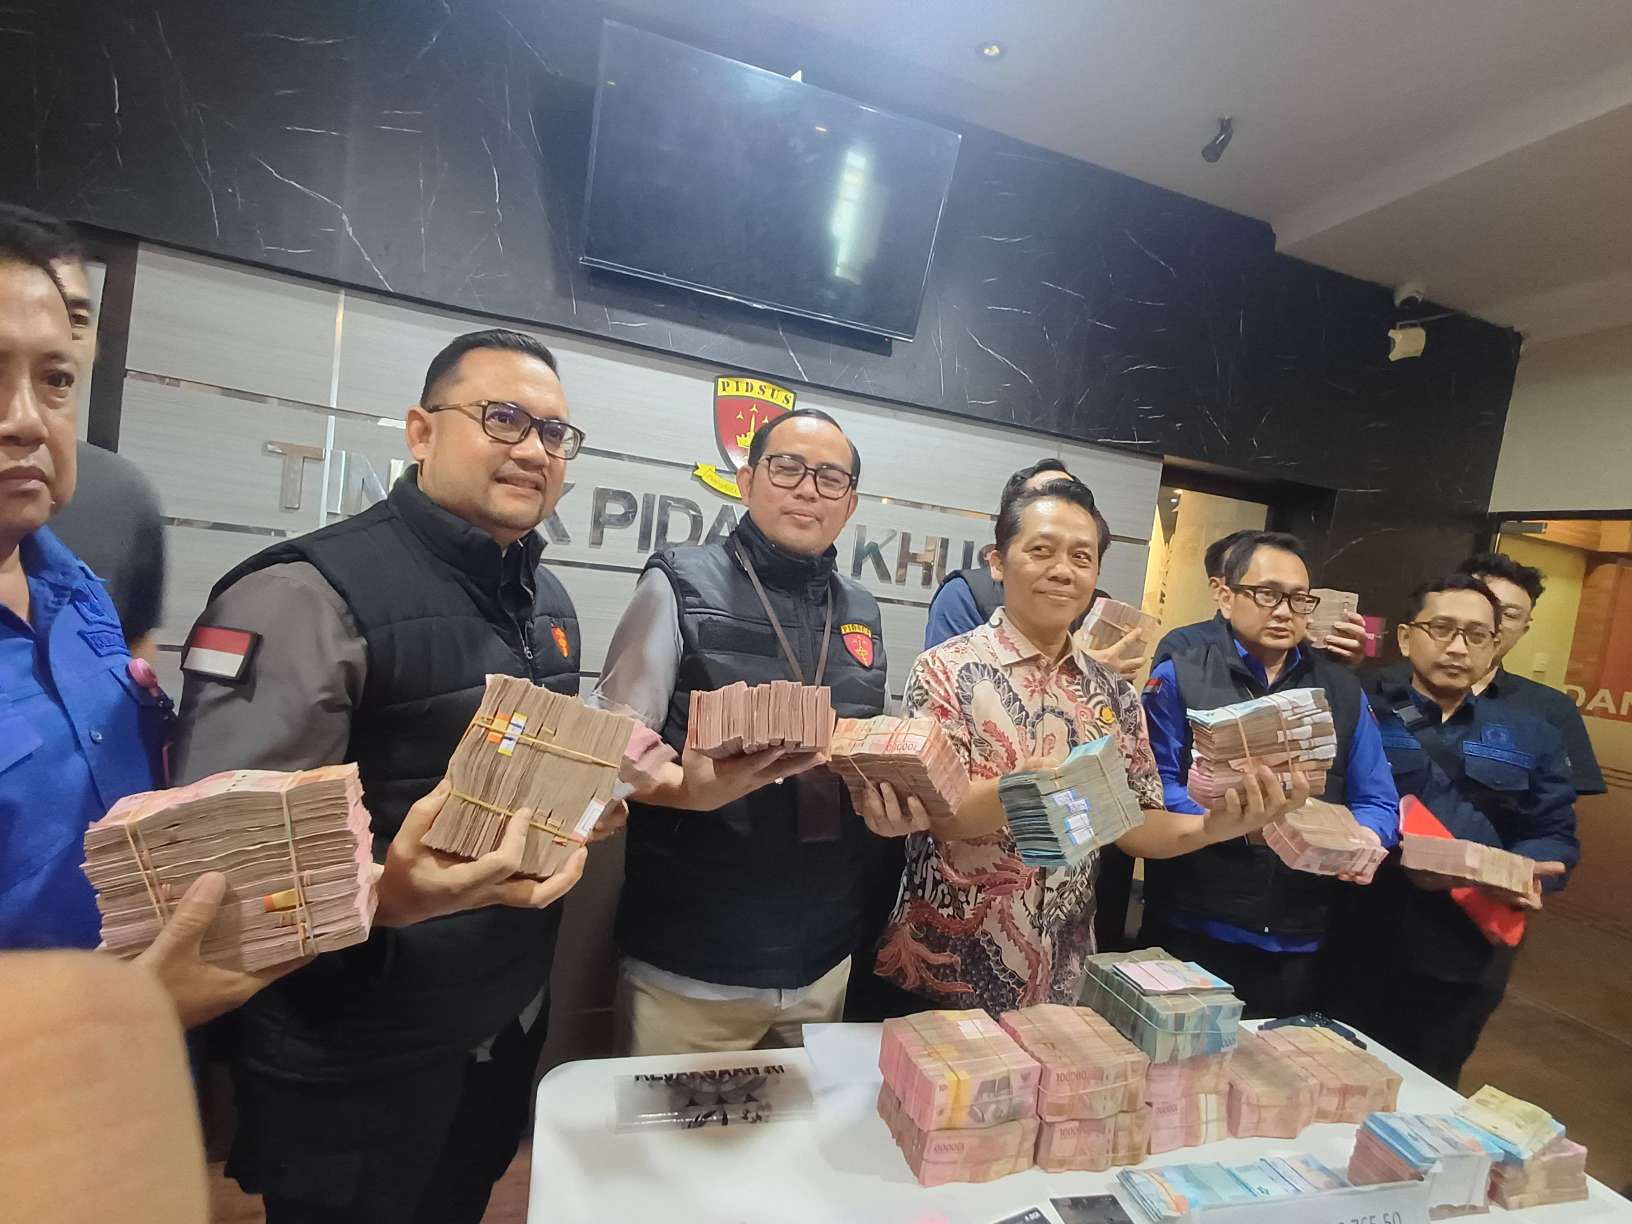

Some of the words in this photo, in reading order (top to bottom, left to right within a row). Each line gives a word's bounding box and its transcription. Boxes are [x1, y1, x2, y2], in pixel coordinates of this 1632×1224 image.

[721, 380, 793, 406] PIDSUS
[263, 440, 575, 545] TINK
[589, 486, 741, 554] PIDA
[851, 524, 975, 589] KHU
